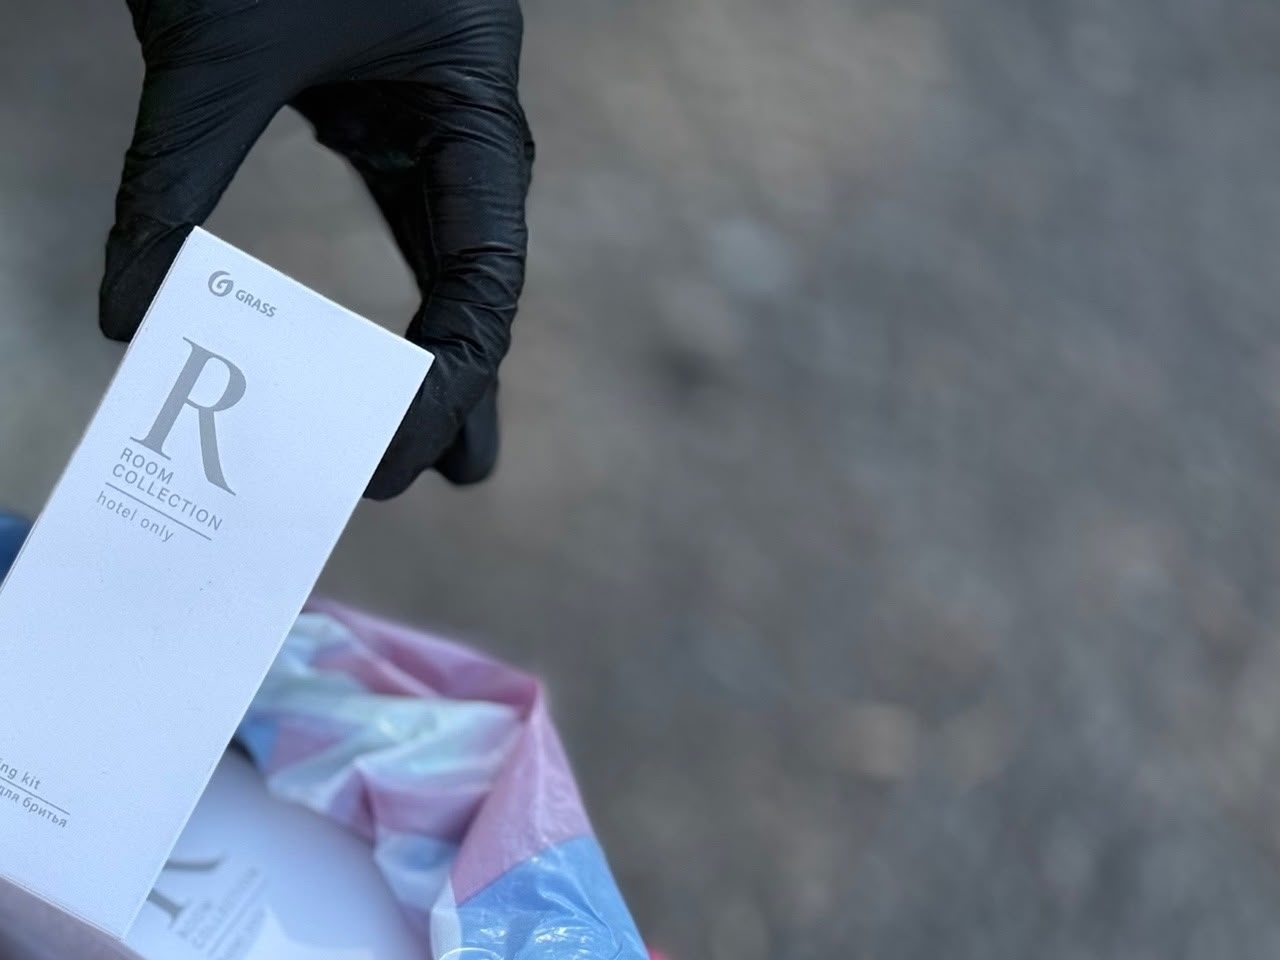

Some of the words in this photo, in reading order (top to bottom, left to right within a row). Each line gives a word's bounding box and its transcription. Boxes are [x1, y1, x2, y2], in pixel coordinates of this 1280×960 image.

[235, 289, 277, 318] GRASS
[130, 336, 247, 496] R
[120, 447, 174, 484] ROOM
[112, 463, 223, 531] COLLECTION
[96, 490, 136, 522] hotel
[140, 517, 174, 543] only
[21, 772, 41, 790] kit
[22, 796, 67, 828] бритья
